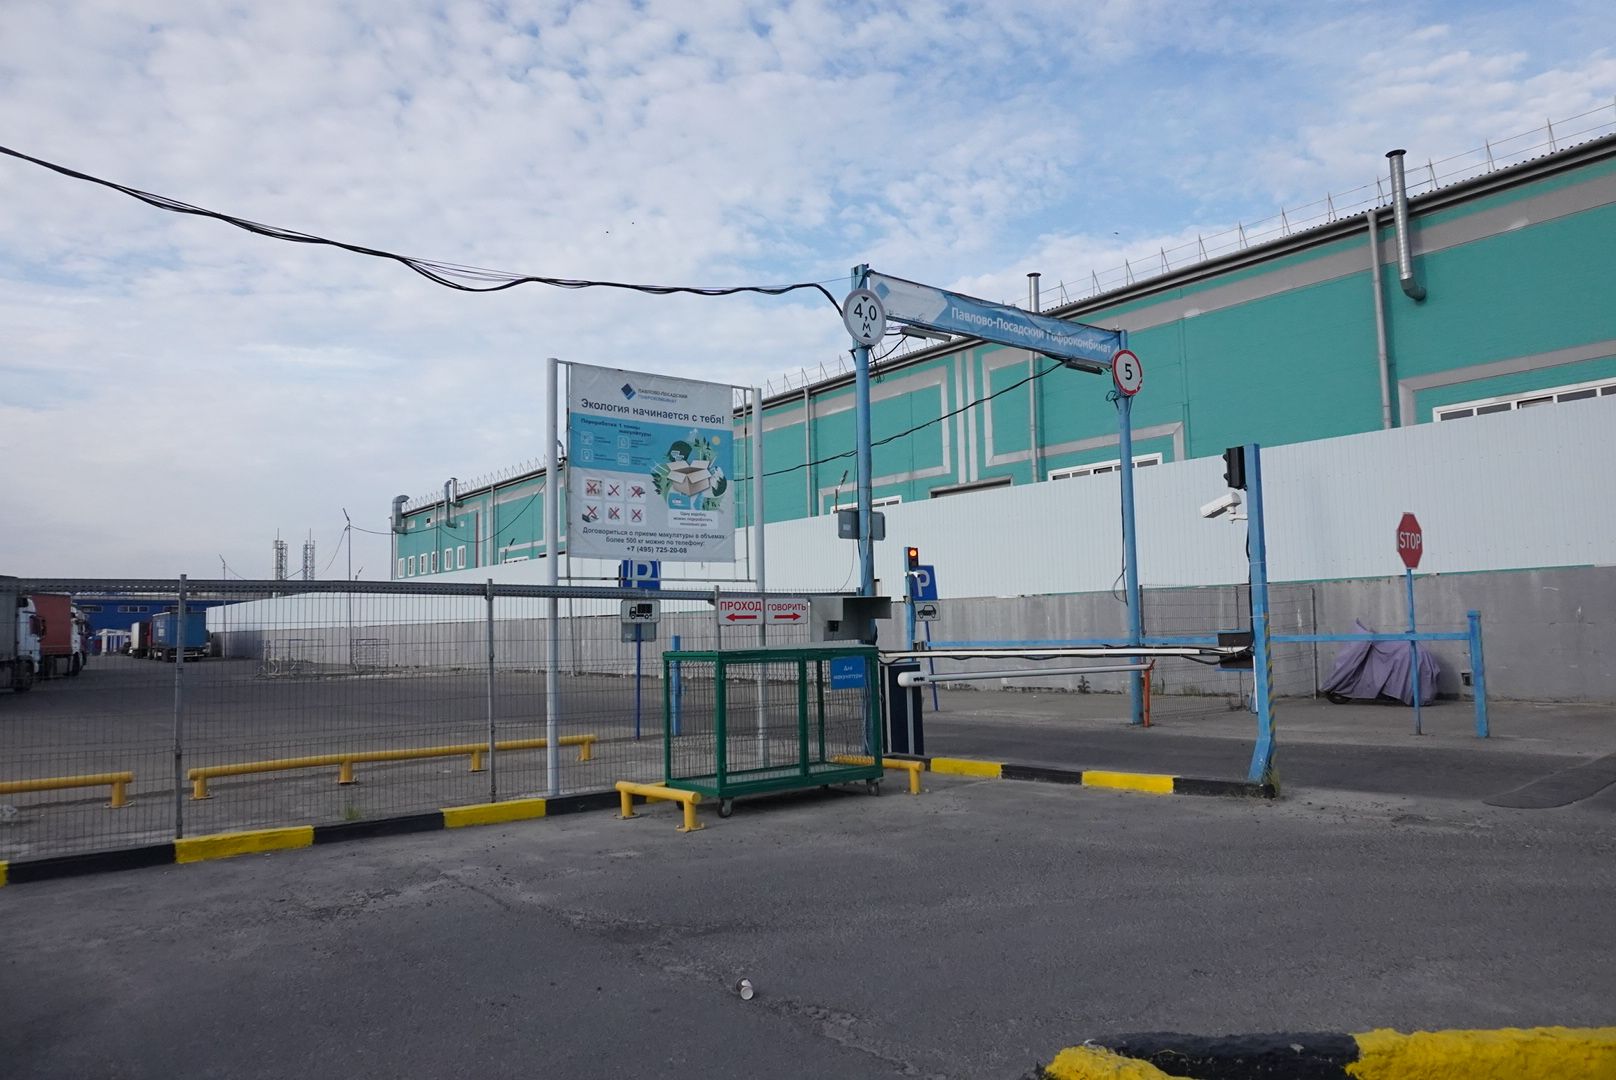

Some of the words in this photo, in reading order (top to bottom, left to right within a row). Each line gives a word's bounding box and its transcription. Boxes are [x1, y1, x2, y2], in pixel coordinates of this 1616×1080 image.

[854, 303, 877, 321] 4,0
[951, 306, 1045, 339] Павлово-Посадский
[1125, 363, 1133, 381] 5
[581, 398, 630, 415] Экология
[632, 407, 690, 422] начинается
[691, 413, 698, 423] с
[699, 415, 725, 425] тебя!
[582, 526, 628, 536] Договориться
[658, 531, 695, 539] макулатуры
[605, 535, 625, 544] более
[1399, 531, 1421, 550] STOP
[636, 545, 654, 554] (495)
[632, 560, 653, 589] P
[916, 569, 931, 598] P
[720, 601, 762, 612] ПРОХОД
[767, 603, 807, 611] ГОВОРИТЬ
